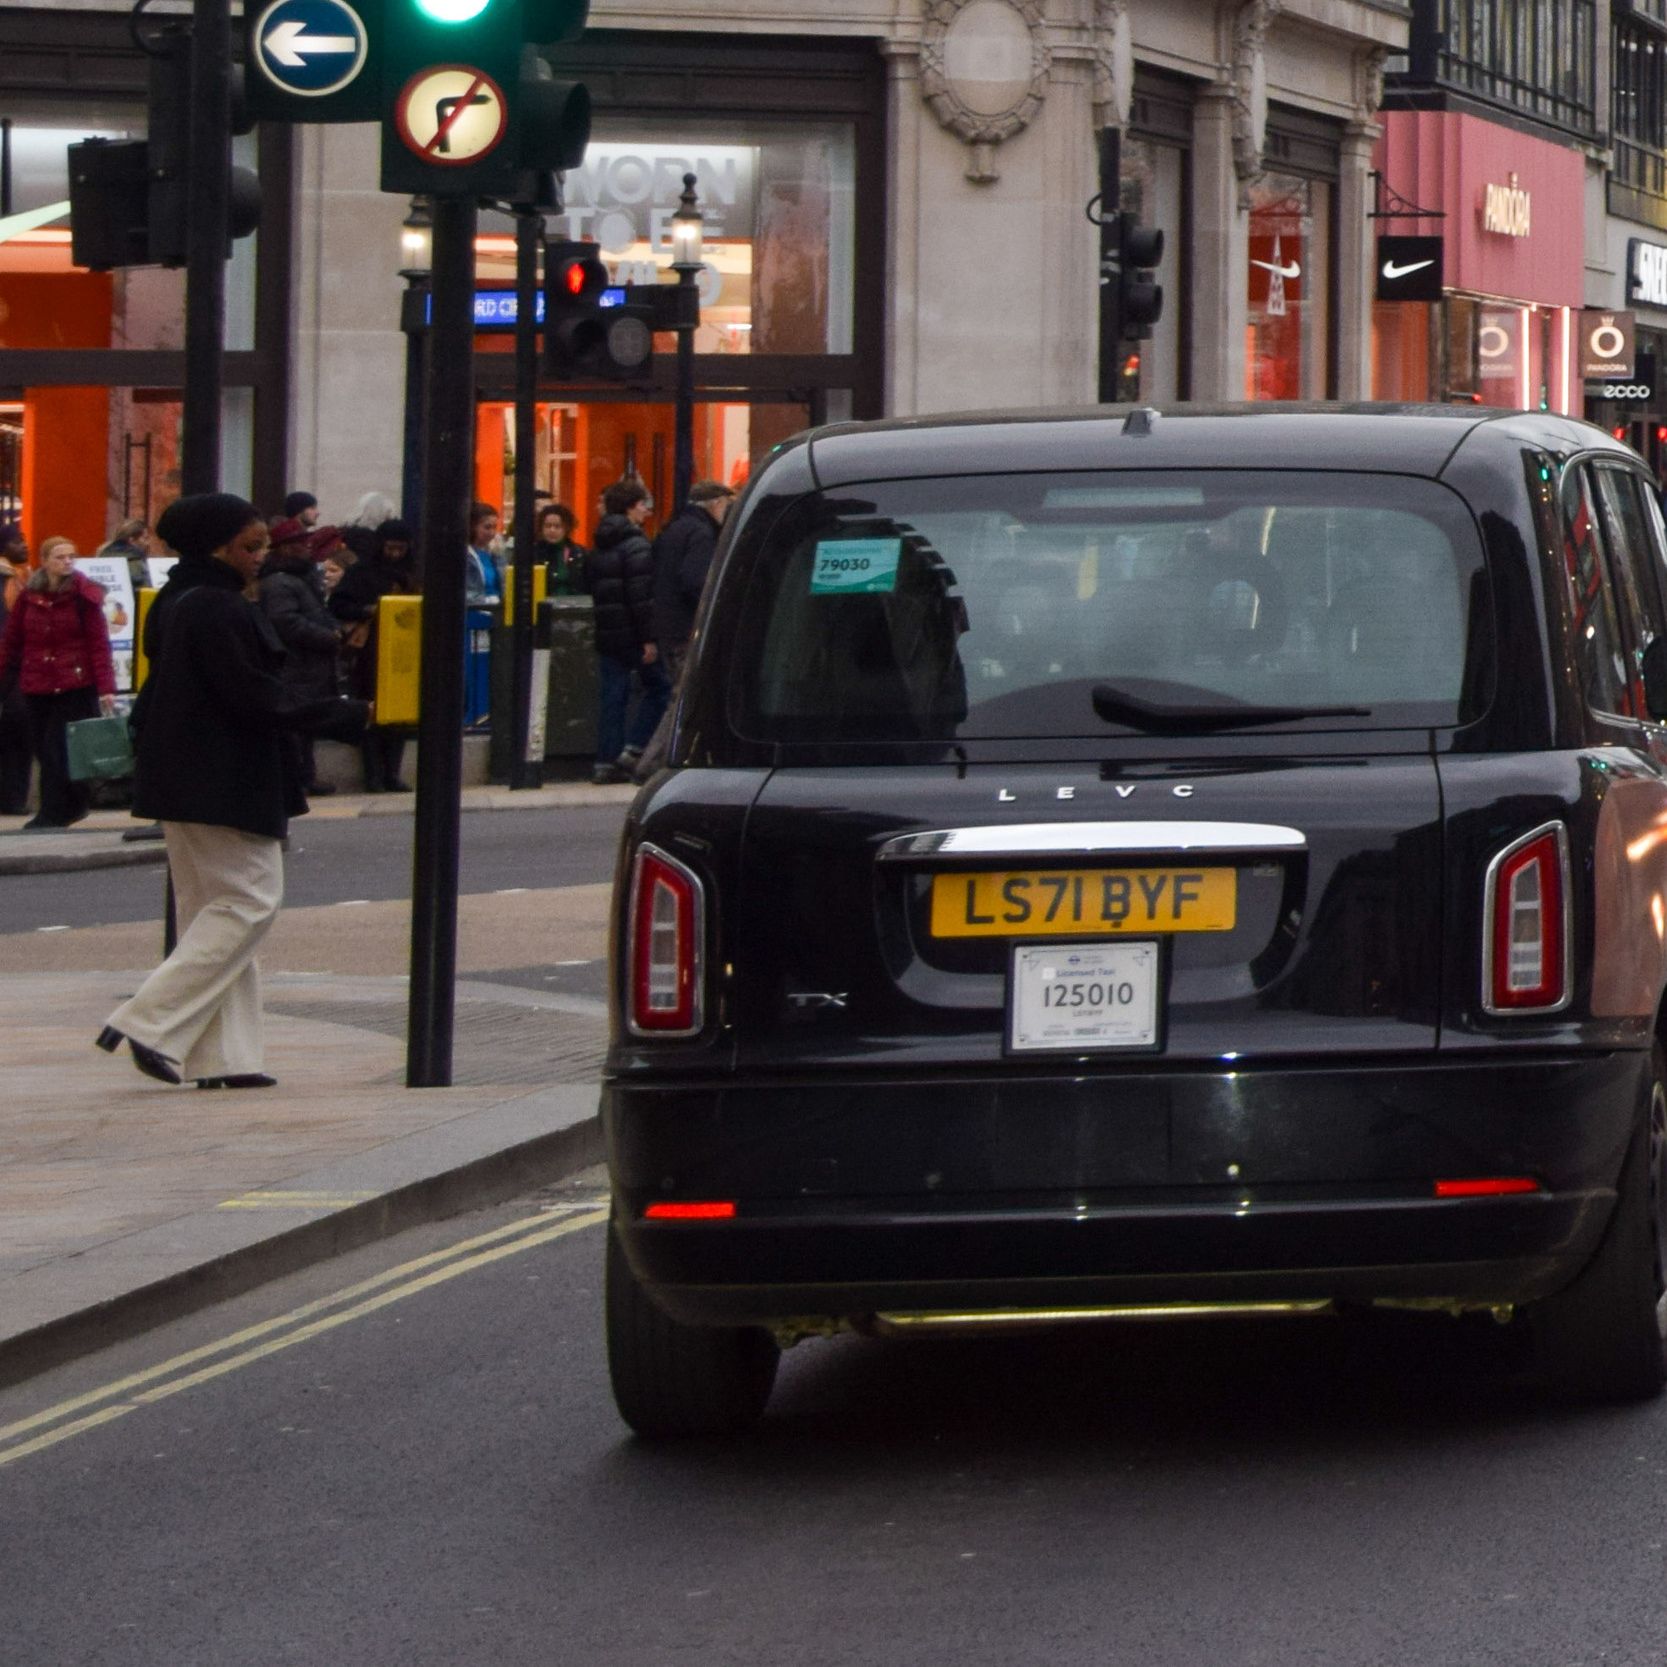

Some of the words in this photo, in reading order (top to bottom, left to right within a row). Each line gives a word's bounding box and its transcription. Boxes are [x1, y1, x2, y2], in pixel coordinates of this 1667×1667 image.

[1603, 384, 1651, 399] ecco
[820, 557, 871, 572] 79030
[998, 784, 1195, 802] LEVC
[964, 878, 1084, 926] LS71
[1100, 874, 1205, 920] BYF
[787, 992, 849, 1007] TX
[1044, 981, 1134, 1008] 125010
